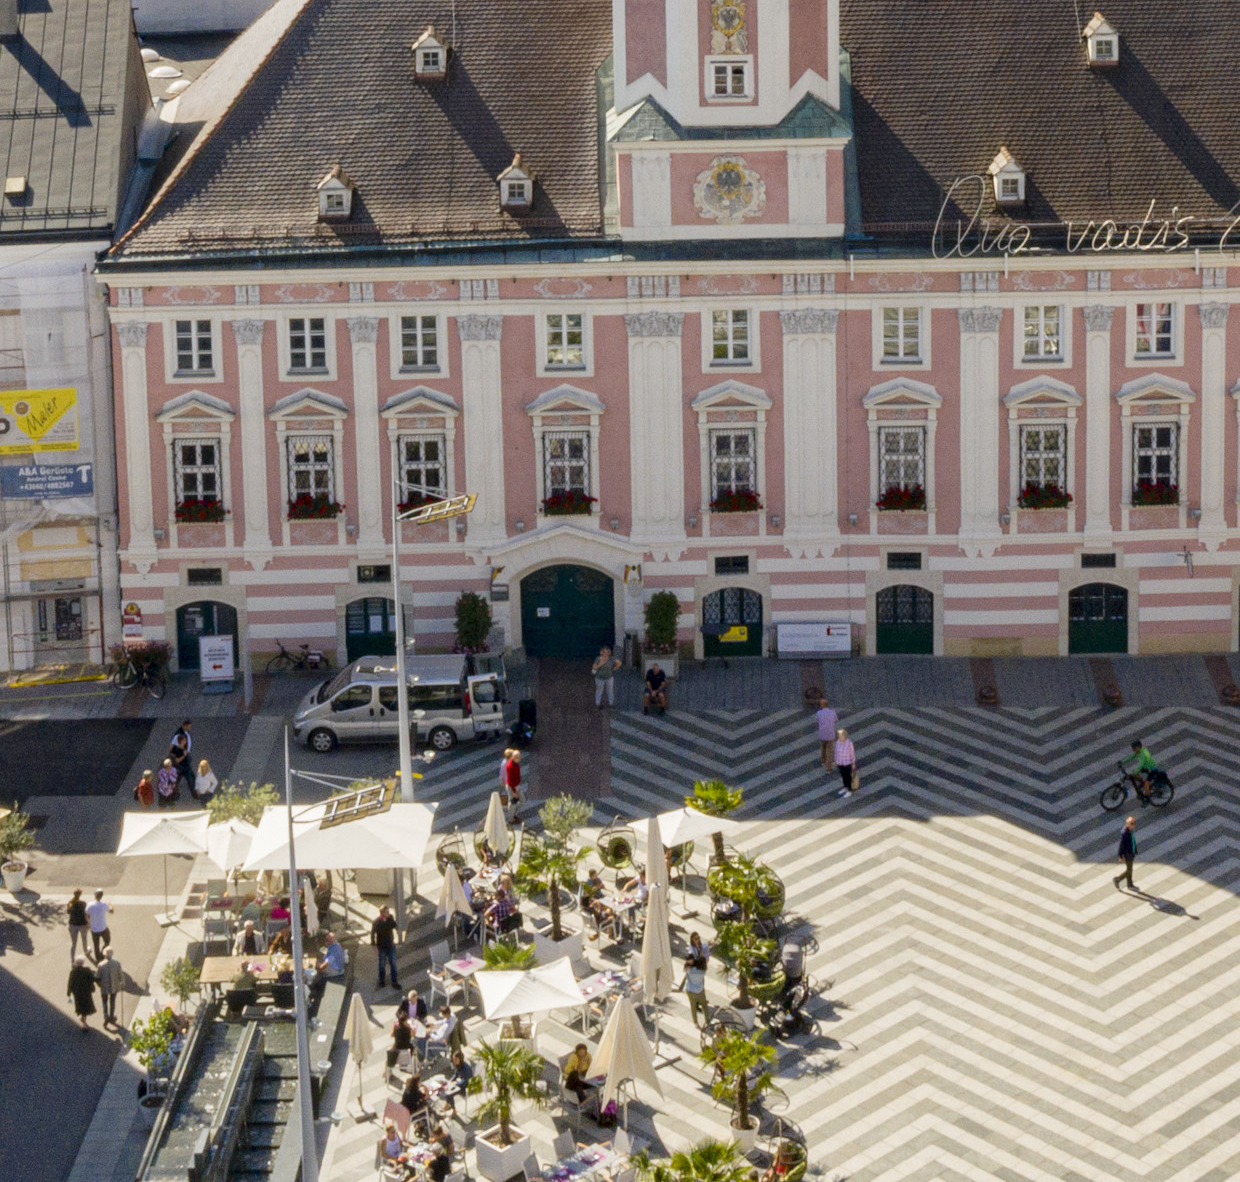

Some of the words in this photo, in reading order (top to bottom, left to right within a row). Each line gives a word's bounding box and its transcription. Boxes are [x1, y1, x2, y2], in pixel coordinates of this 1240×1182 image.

[932, 175, 1029, 259] Quo
[1066, 199, 1194, 253] vadis
[26, 396, 57, 435] Maler
[40, 466, 73, 475] Gerüste
